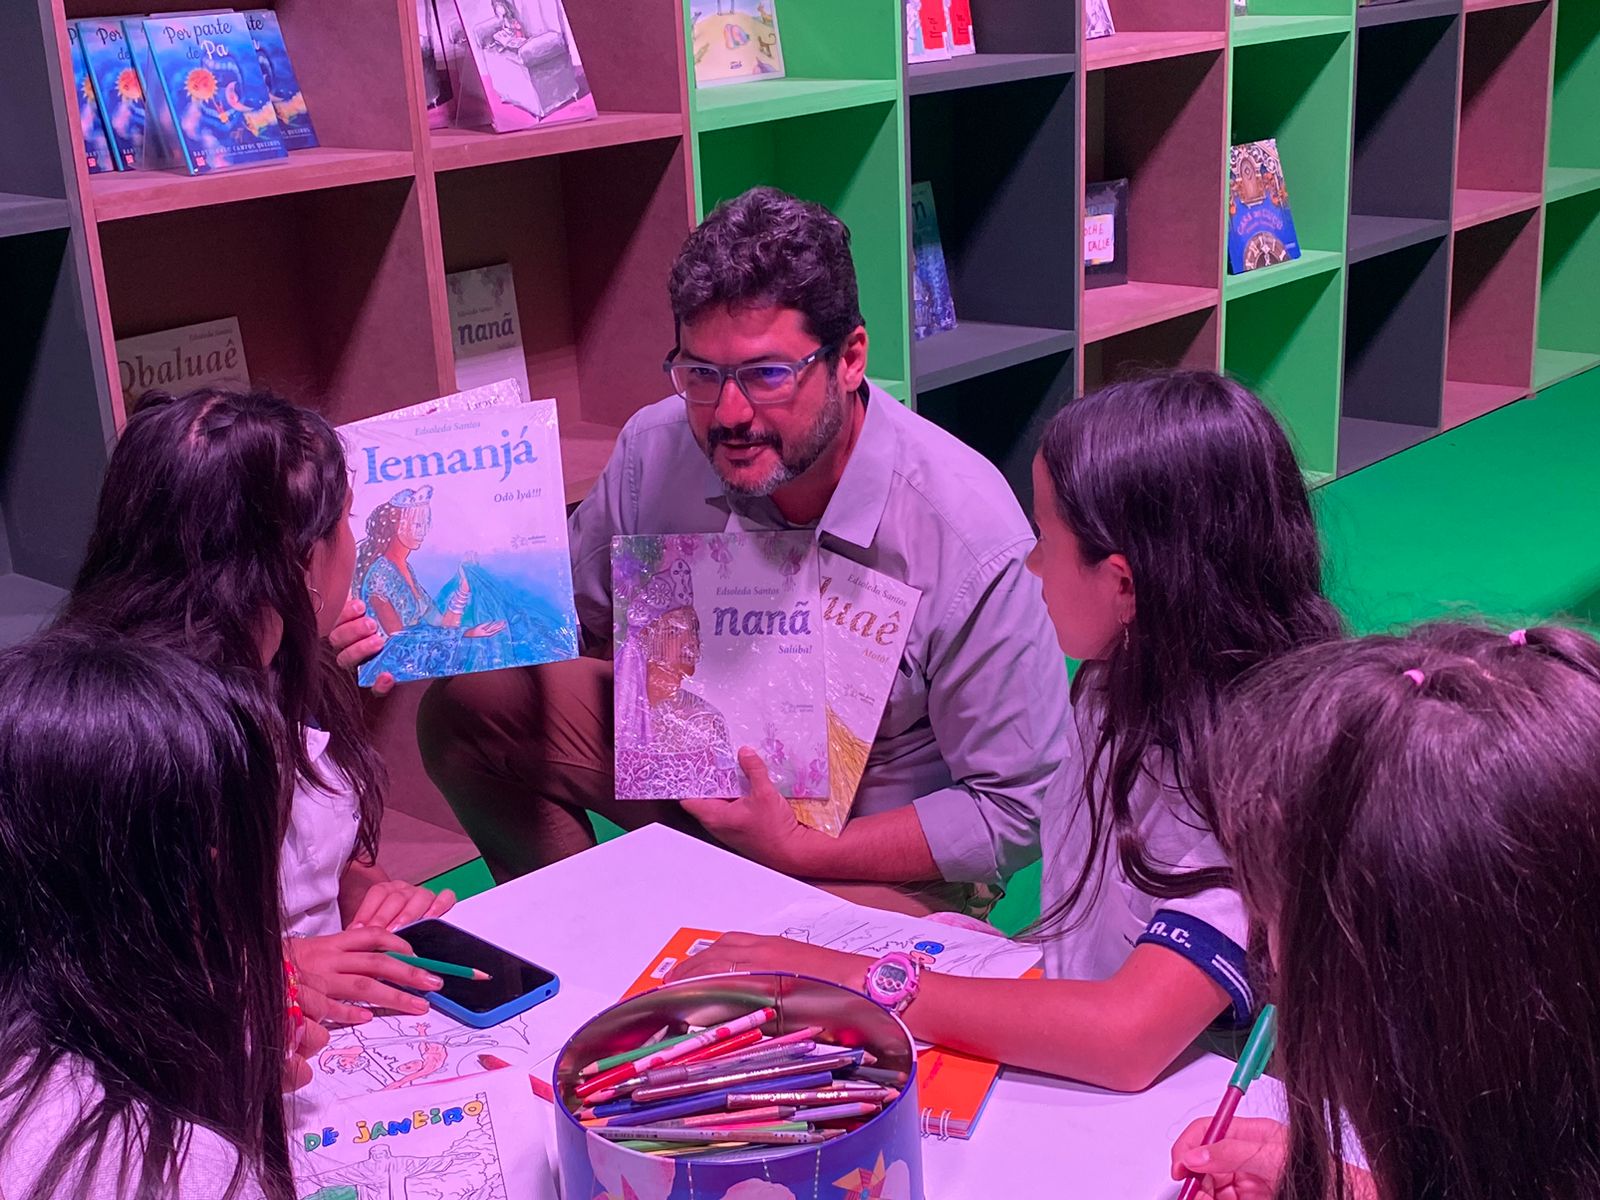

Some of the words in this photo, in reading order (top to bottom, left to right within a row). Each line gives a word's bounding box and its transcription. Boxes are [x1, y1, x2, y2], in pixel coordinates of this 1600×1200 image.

[163, 26, 191, 44] Por
[193, 18, 233, 44] parte
[458, 312, 514, 346] nanã
[362, 425, 538, 485] Iemanjá
[754, 585, 780, 595] Santos
[882, 589, 907, 607] Santos
[712, 600, 812, 637] nanã
[303, 1127, 340, 1153] DE
